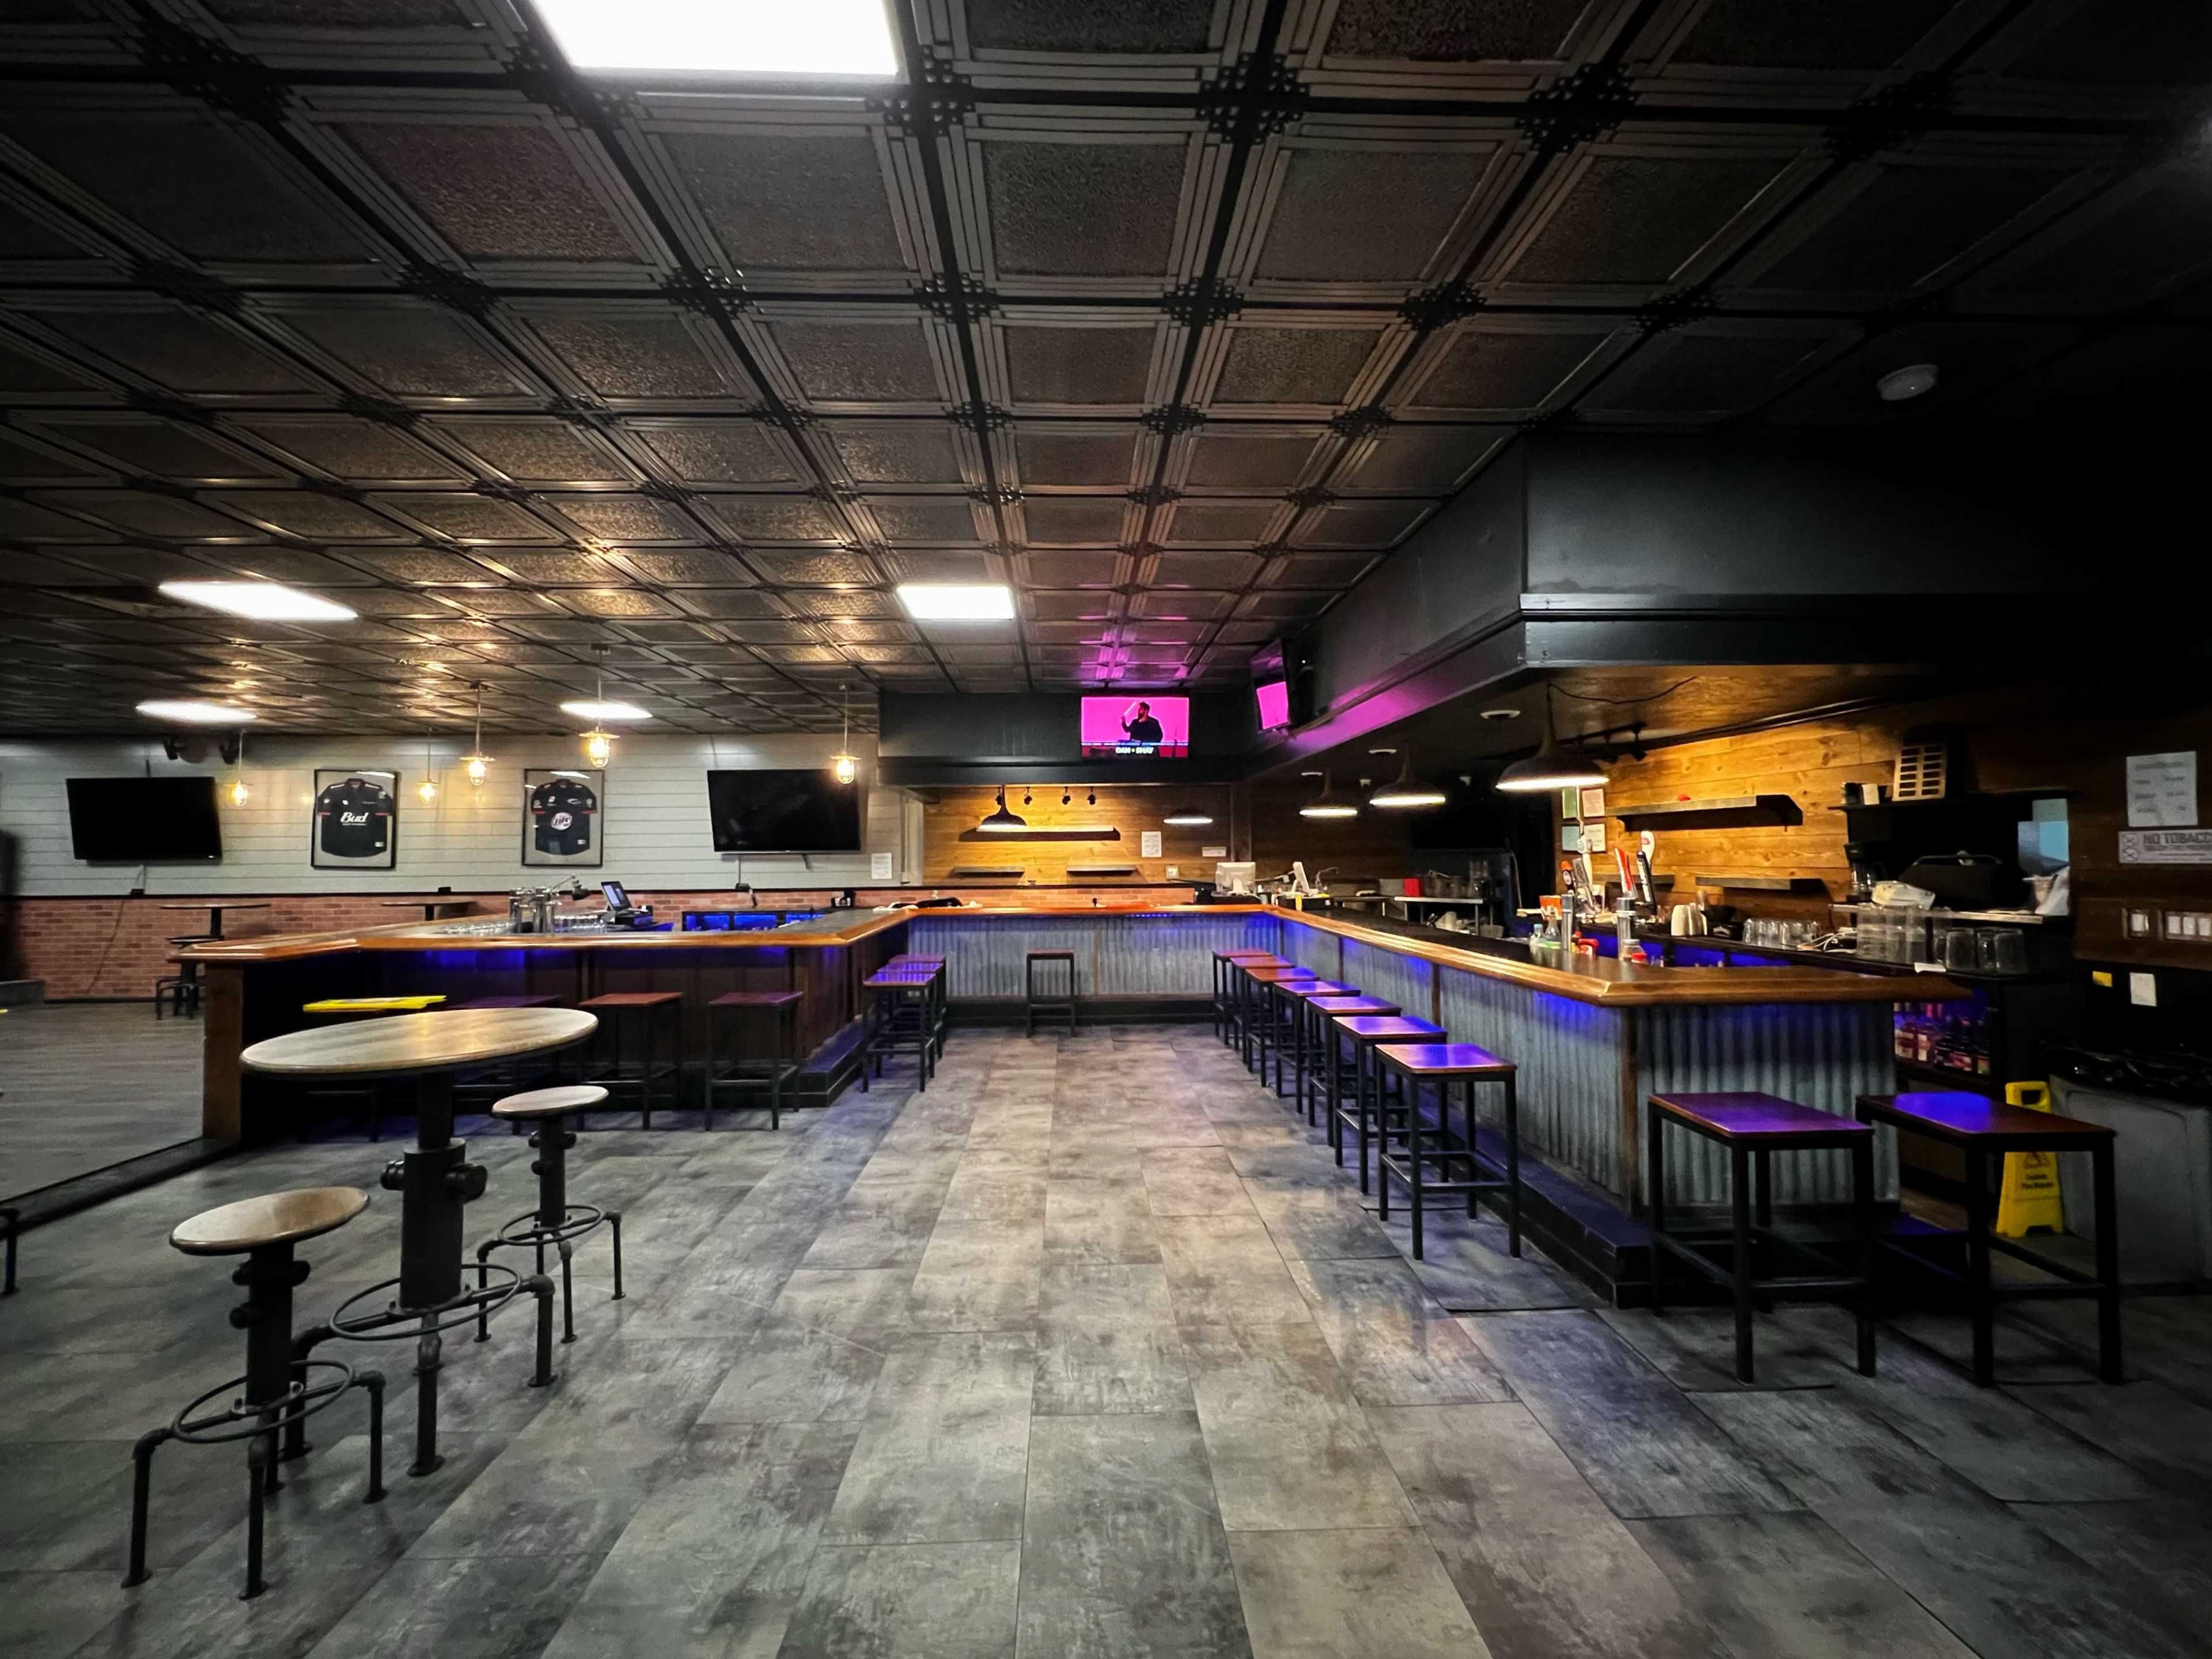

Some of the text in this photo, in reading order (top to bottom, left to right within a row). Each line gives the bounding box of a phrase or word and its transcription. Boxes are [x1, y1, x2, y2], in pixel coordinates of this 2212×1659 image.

[340, 812, 369, 823] Bud
[2143, 832, 2212, 844] NO TOBACC
